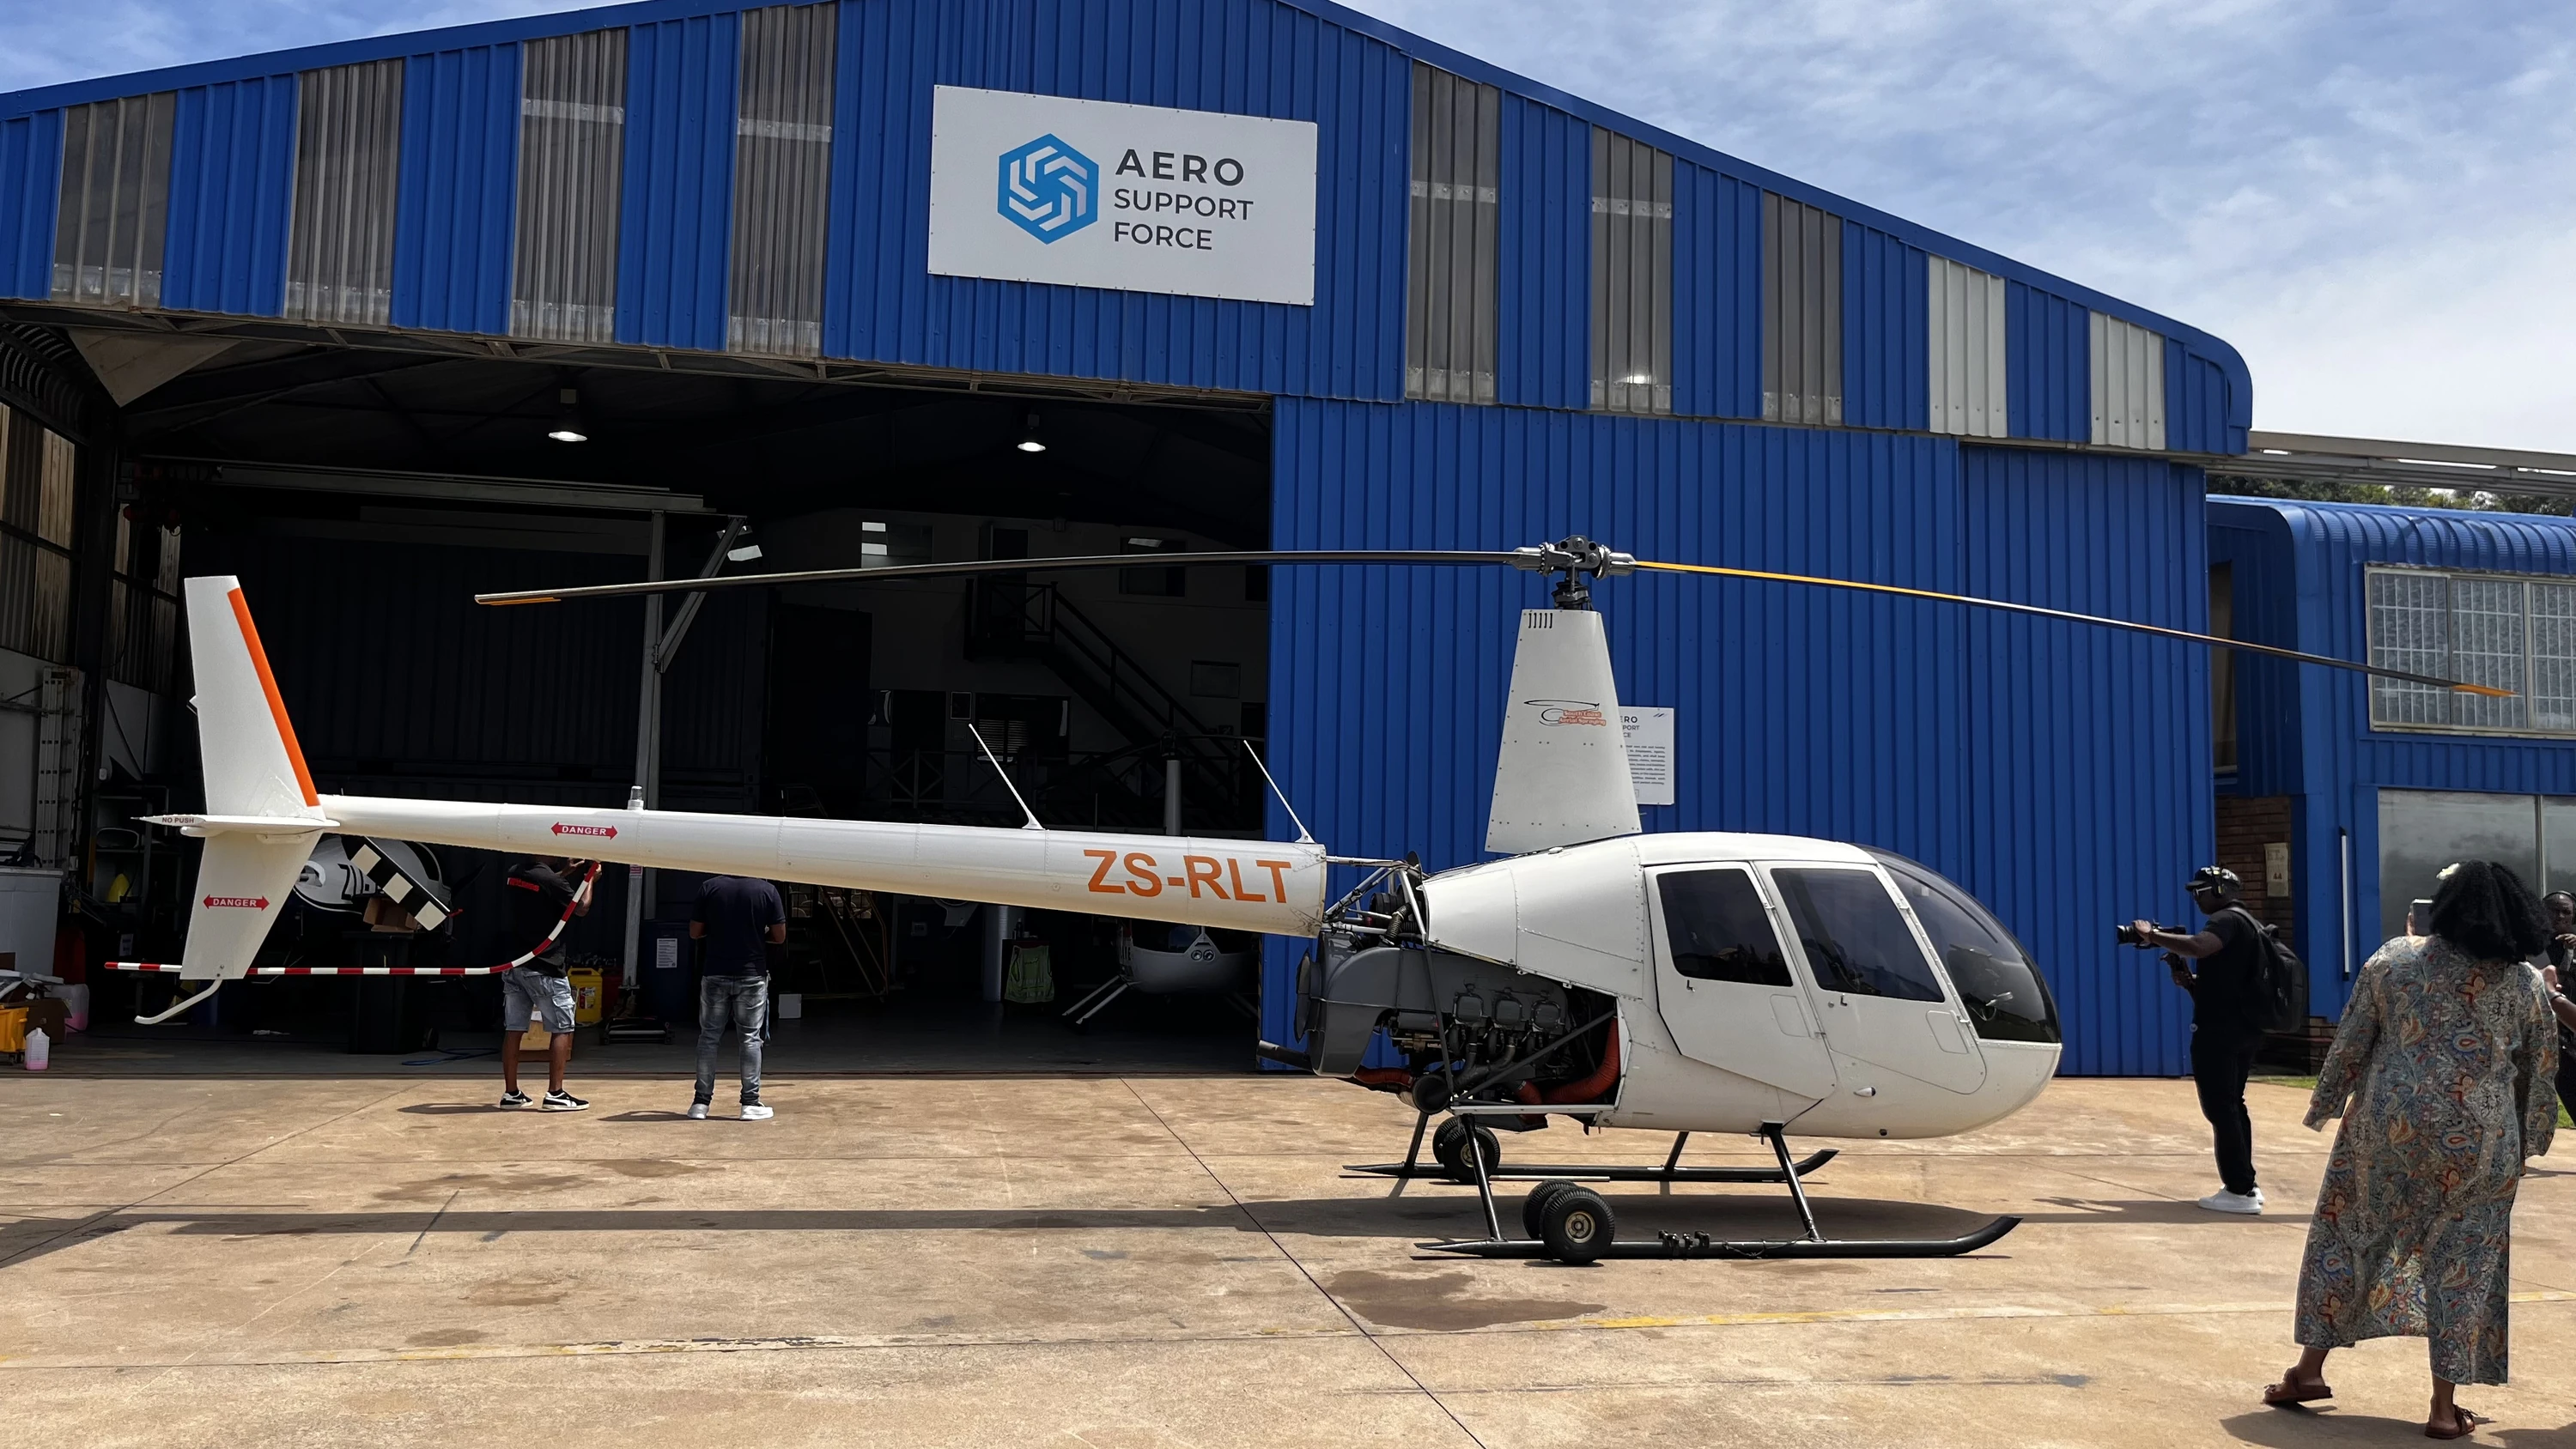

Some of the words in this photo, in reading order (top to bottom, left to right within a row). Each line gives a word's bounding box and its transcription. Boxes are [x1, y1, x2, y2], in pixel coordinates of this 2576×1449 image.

[1115, 149, 1245, 186] AERO
[1114, 188, 1254, 221] SUPPORT
[1115, 221, 1212, 250] FORCE
[562, 825, 606, 836] DANGER
[1084, 849, 1291, 903] ZS-RLT
[213, 898, 257, 907] DANGER
